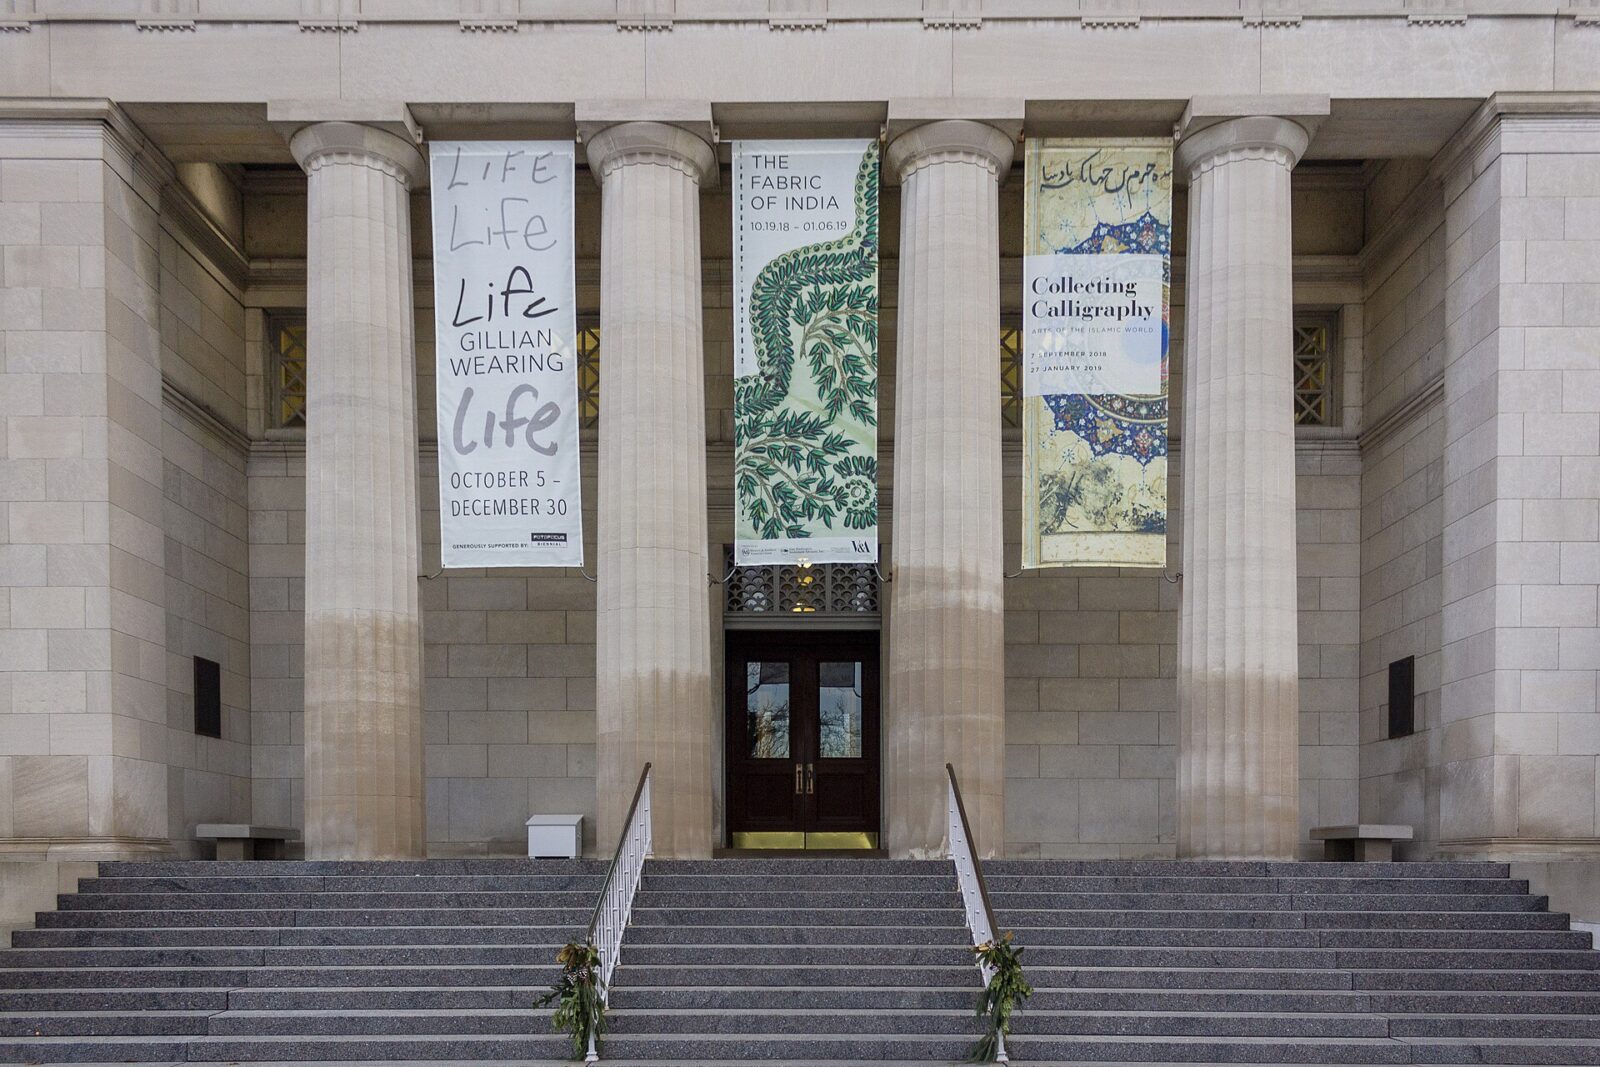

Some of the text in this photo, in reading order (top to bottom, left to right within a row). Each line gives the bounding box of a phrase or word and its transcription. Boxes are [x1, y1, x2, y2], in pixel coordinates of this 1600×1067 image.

[752, 155, 789, 169] THE
[751, 175, 822, 190] FABRIC
[751, 196, 839, 210] OF INDIA
[750, 222, 790, 231] 10.19.18
[803, 221, 847, 231] 01.06.19
[1032, 276, 1137, 298] Collecting
[1031, 300, 1154, 321] Calligraphy
[460, 328, 552, 352] GILLIAN
[450, 353, 564, 376] WEARING
[451, 471, 529, 489] OCTOBER
[537, 471, 545, 487] 5
[451, 498, 567, 517] DECEMBER 30
